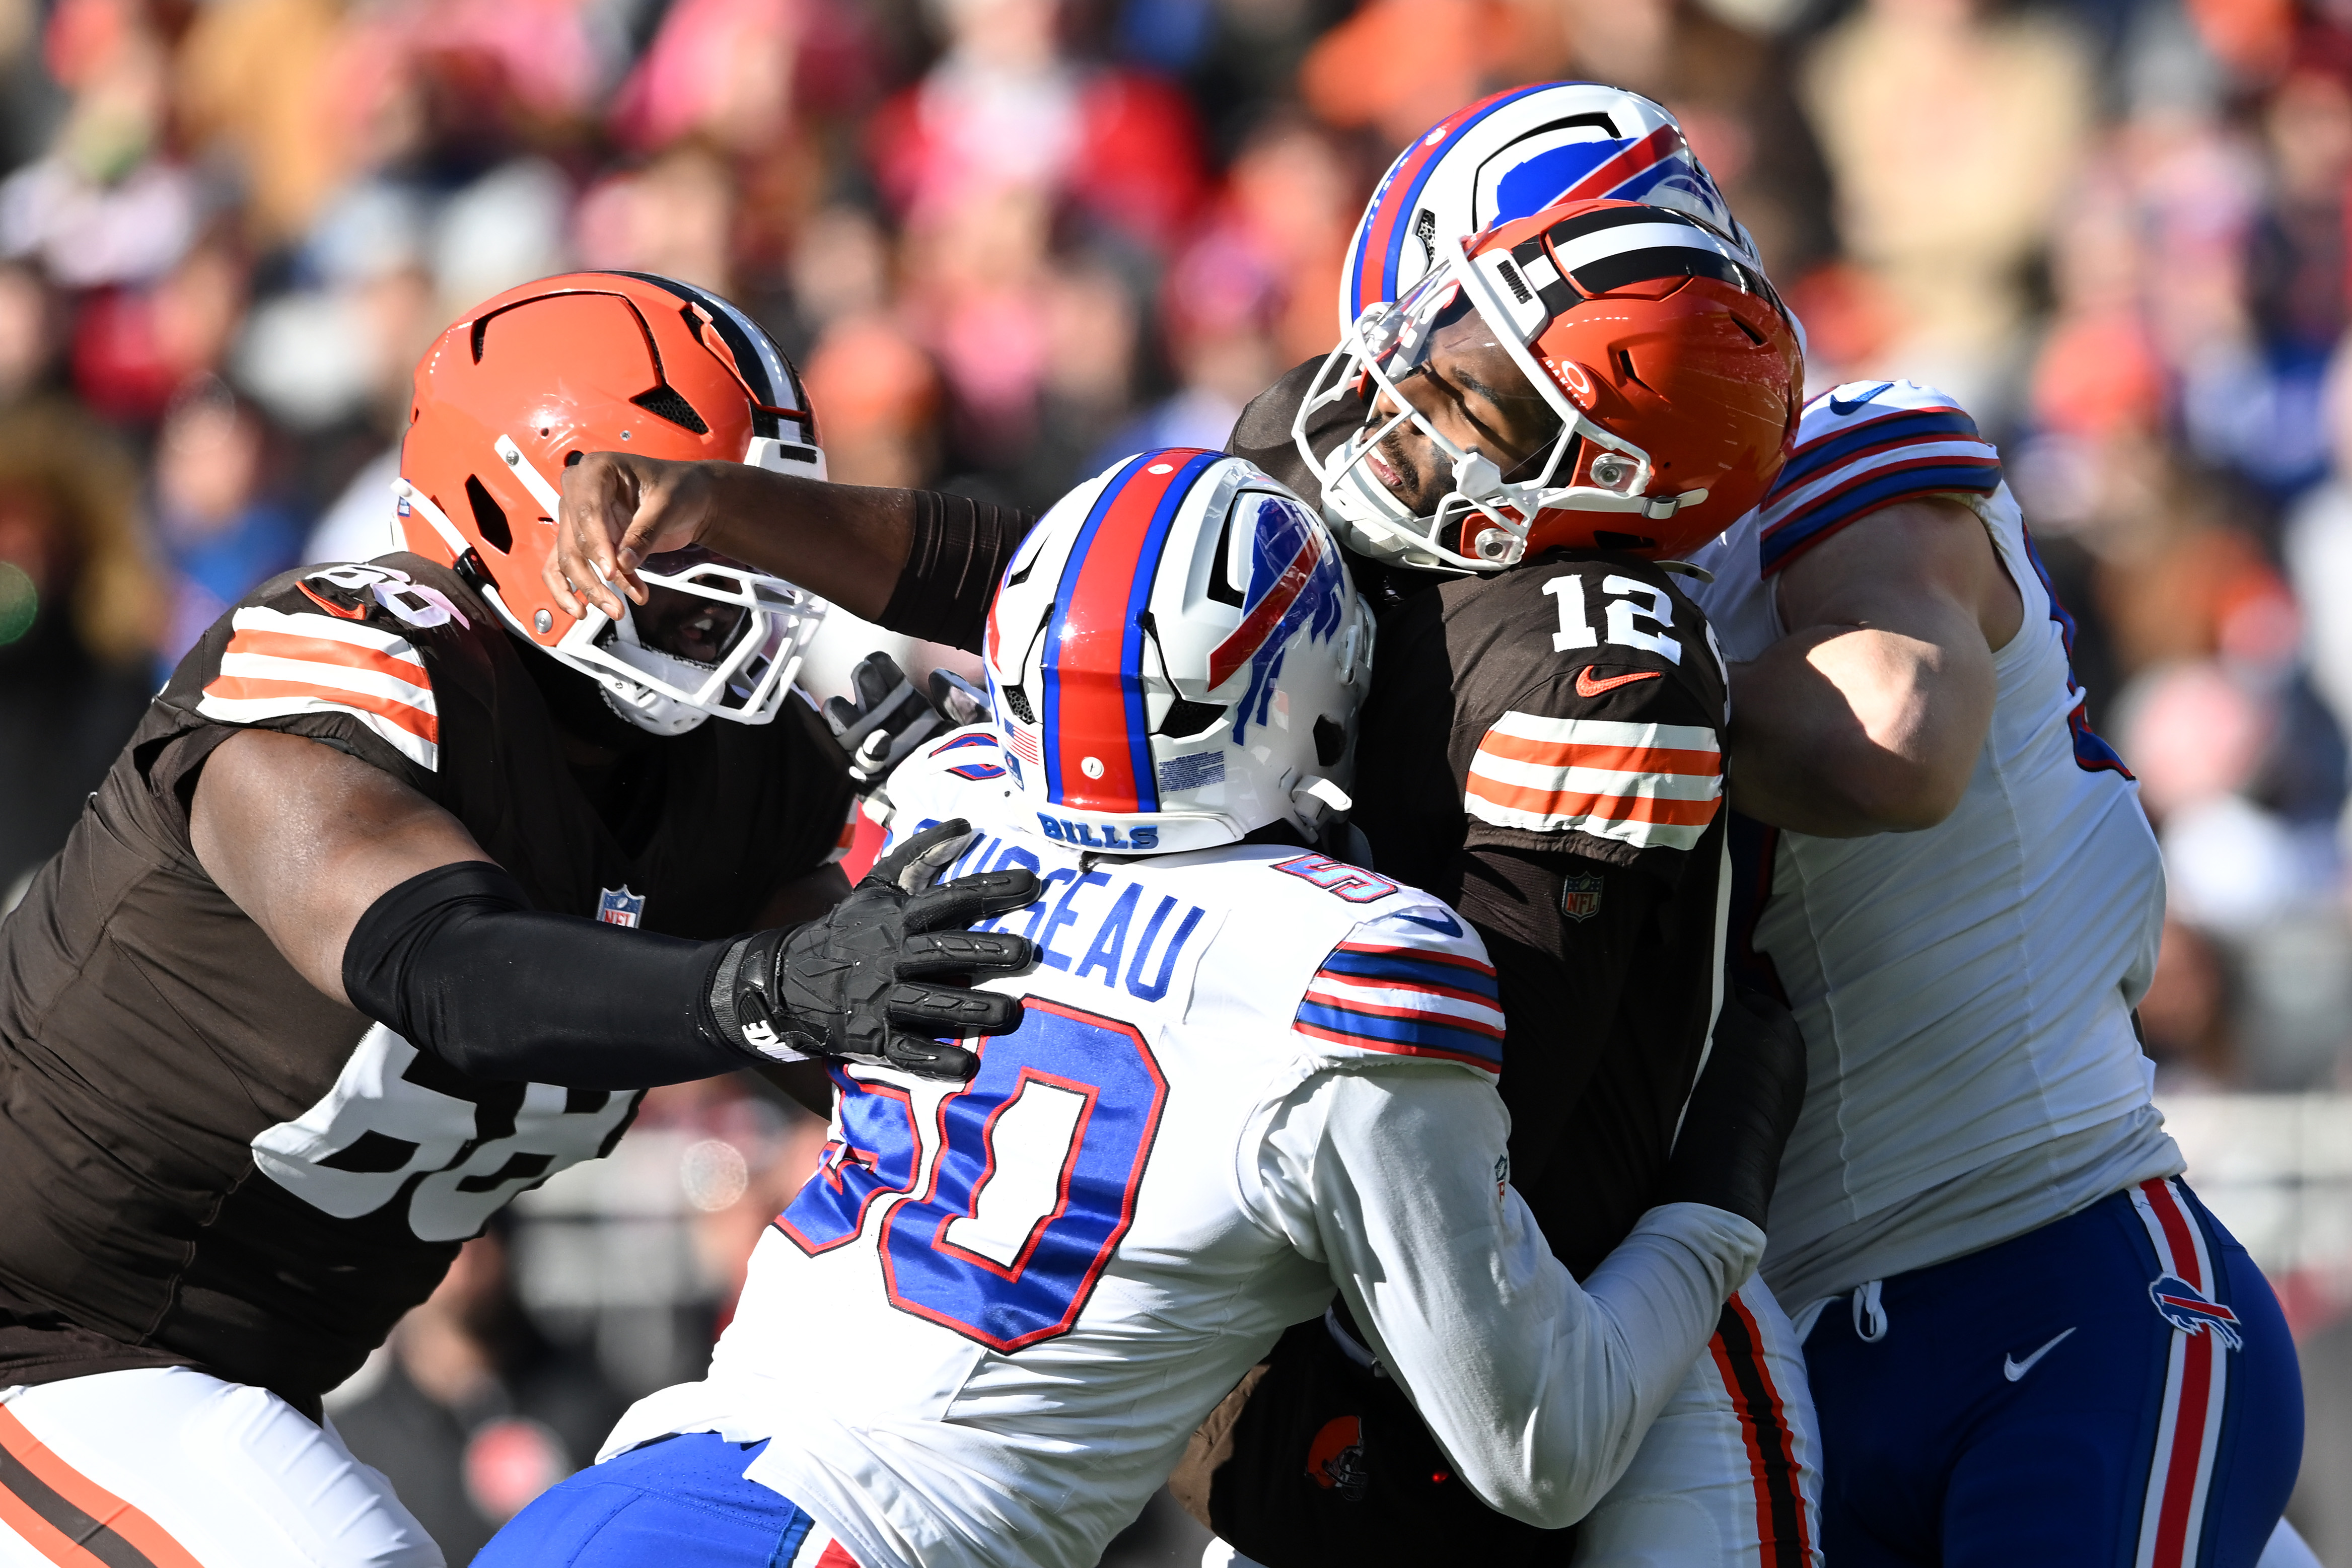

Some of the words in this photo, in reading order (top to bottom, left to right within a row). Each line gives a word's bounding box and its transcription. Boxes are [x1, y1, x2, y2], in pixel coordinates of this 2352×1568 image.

[1496, 260, 1533, 304] BROWNS
[1542, 574, 1682, 666] 12
[1037, 812, 1159, 849] BILLS
[1566, 893, 1596, 915] NFL
[251, 1021, 642, 1242] 68
[774, 993, 1170, 1356] 50
